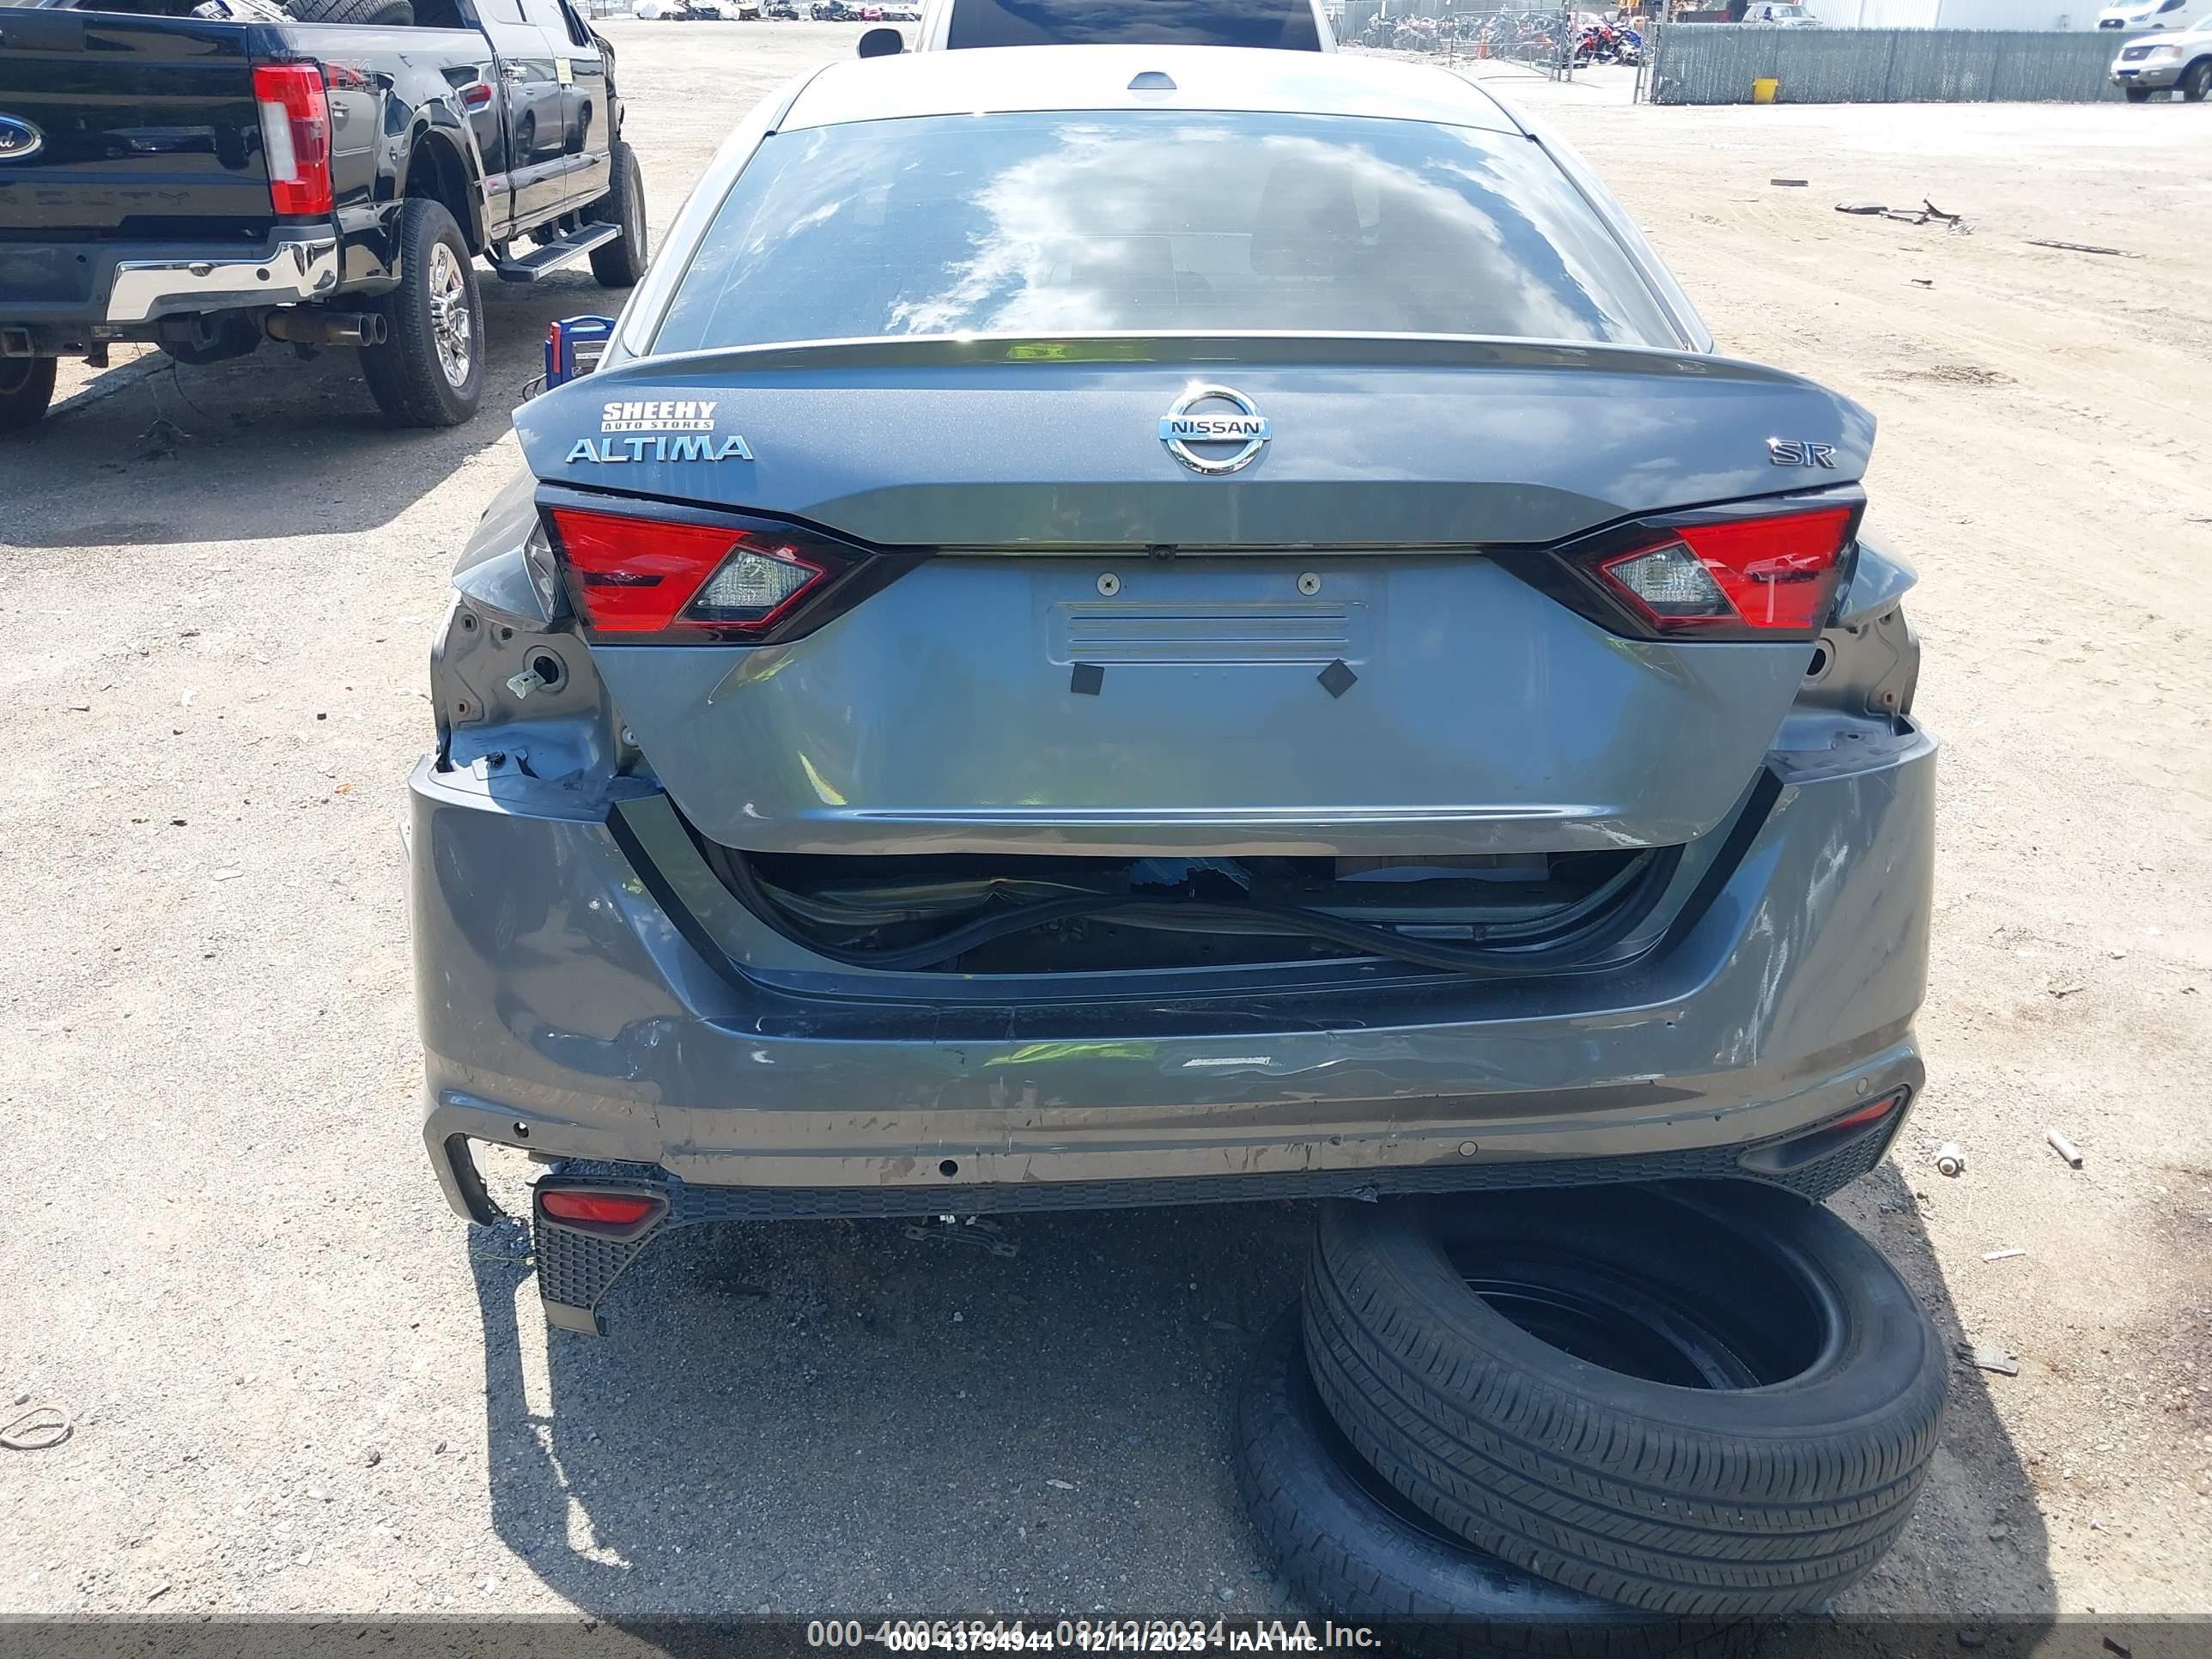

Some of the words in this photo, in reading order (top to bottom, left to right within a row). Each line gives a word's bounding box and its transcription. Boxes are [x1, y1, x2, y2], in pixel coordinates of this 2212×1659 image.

[602, 401, 718, 420] SHEEHY
[605, 422, 642, 430] AUTO
[651, 421, 712, 429] STORES
[1171, 422, 1260, 434] NISSAN
[565, 435, 755, 463] ALTIMA
[1770, 439, 1838, 469] SR
